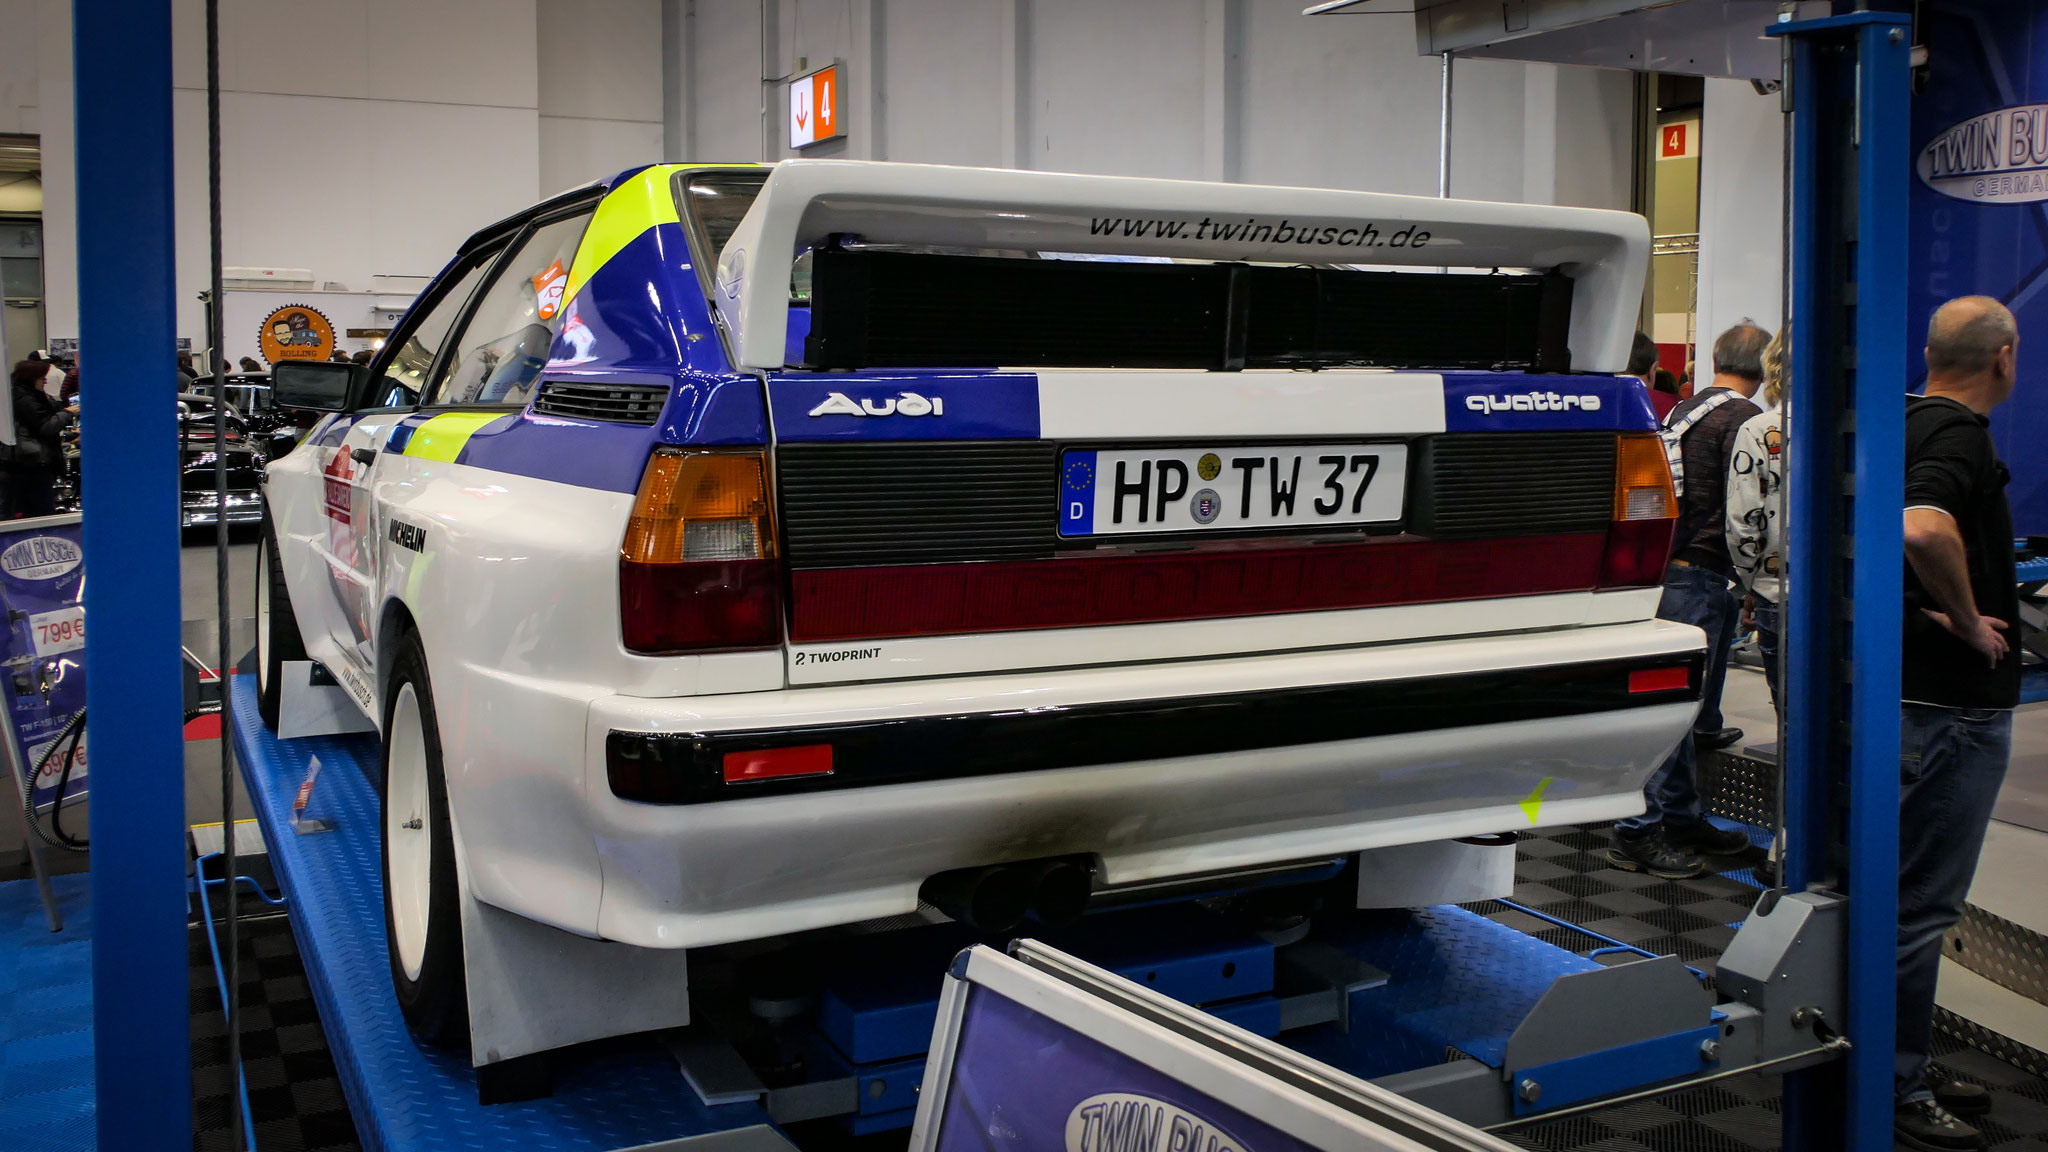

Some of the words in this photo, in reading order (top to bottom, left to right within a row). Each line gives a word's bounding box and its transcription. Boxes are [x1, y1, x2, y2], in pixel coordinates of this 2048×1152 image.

[821, 81, 831, 126] 4
[1669, 130, 1679, 150] 4
[1928, 113, 2001, 175] TWIN
[1973, 174, 2048, 197] GERMA
[1090, 217, 1431, 249] www.twinbusch.de
[808, 392, 944, 417] Audi
[1465, 391, 1601, 415] quattro
[1112, 459, 1189, 524] HP
[1232, 456, 1301, 519] TW
[1314, 454, 1380, 516] 37
[1070, 502, 1084, 520] D
[388, 518, 427, 554] MICHELIN
[4, 540, 35, 569] TWIN
[33, 539, 77, 563] BUSCH
[809, 647, 881, 664] TWOPRINT
